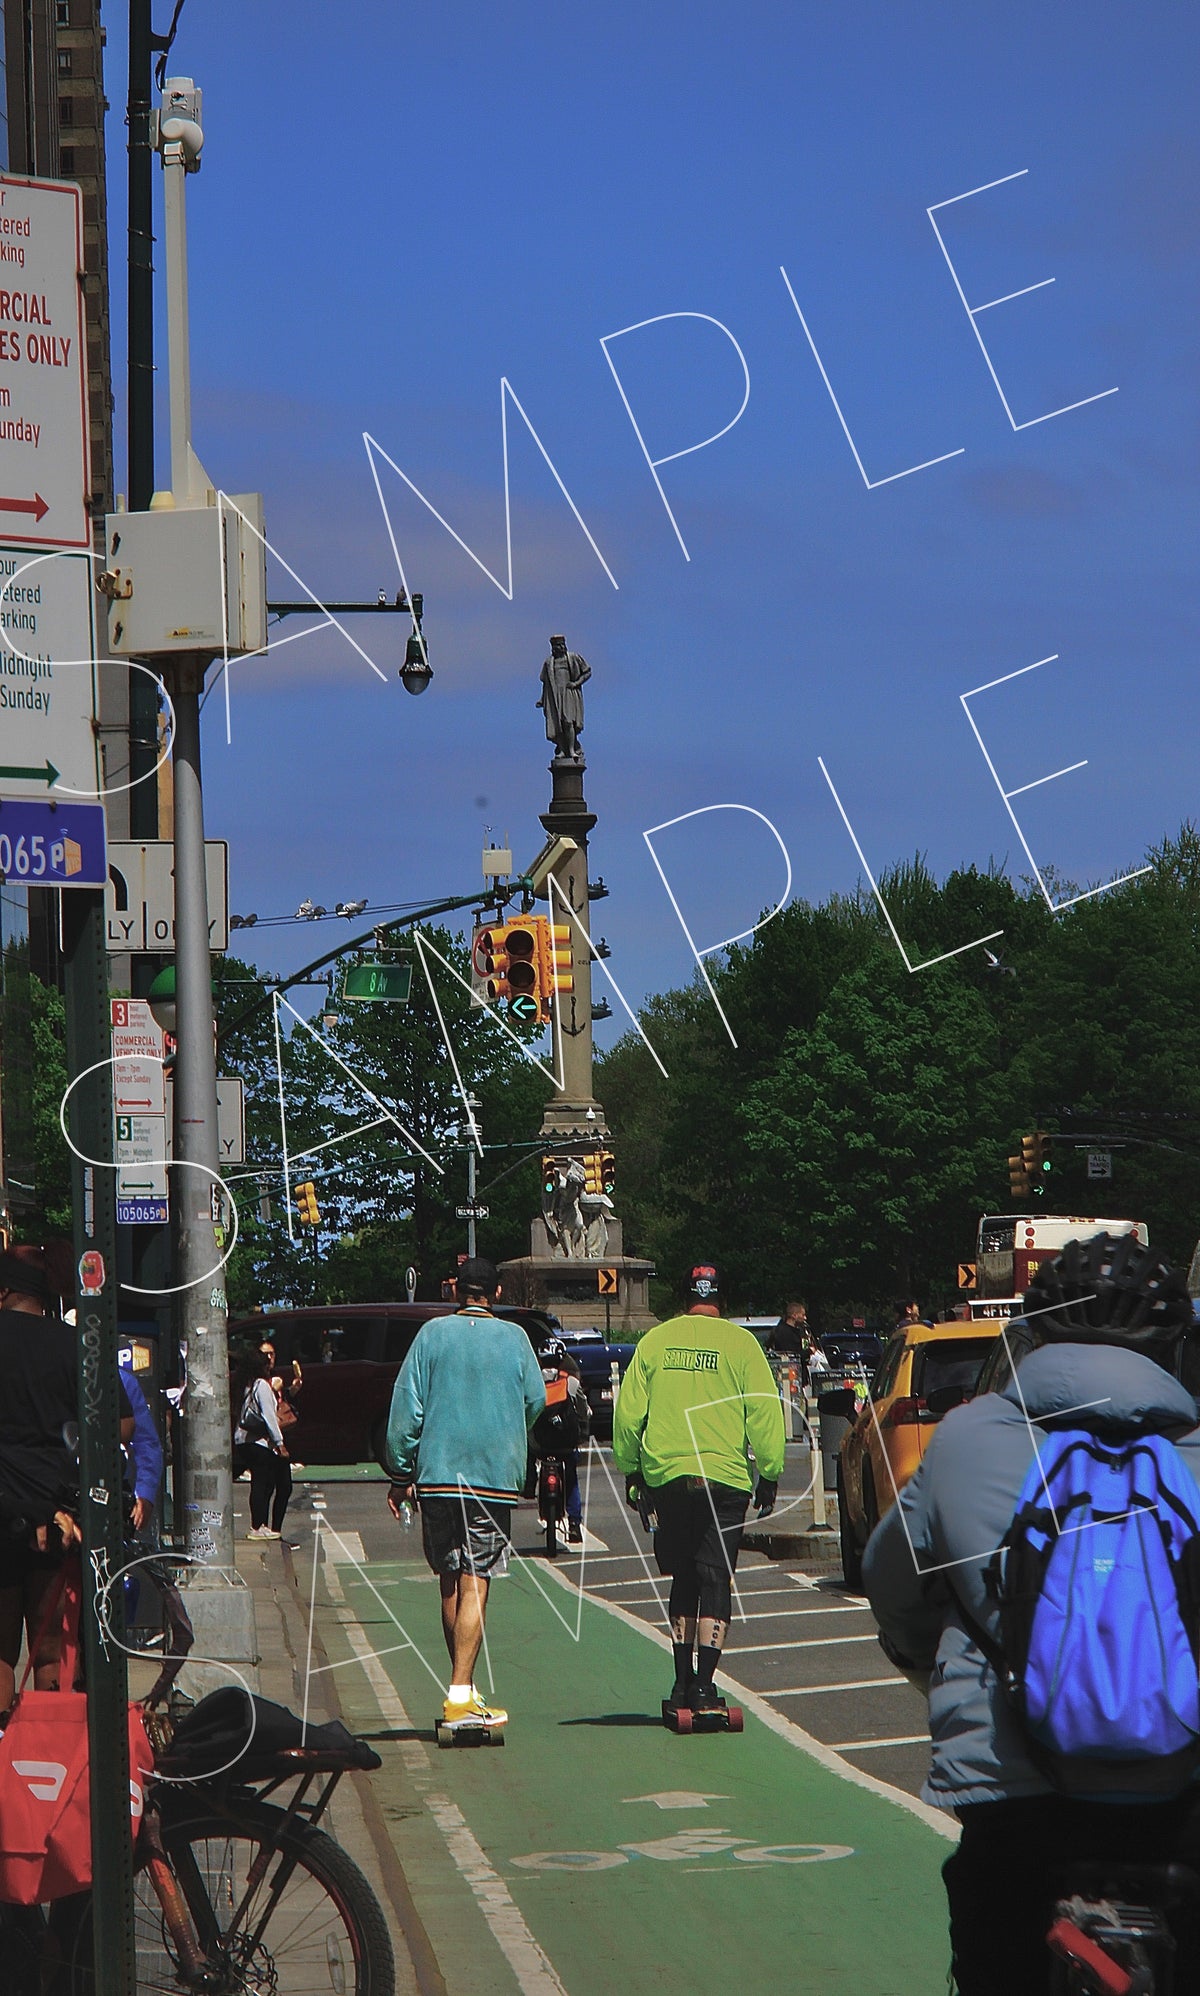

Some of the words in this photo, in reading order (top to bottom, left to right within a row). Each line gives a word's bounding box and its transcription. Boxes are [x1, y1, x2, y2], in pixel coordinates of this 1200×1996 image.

[0, 241, 25, 268] king
[0, 290, 52, 326] RCIAL
[0, 330, 21, 362] ES
[27, 333, 72, 367] ONLY
[0, 417, 41, 449] unday
[0, 684, 51, 716] Sunday
[0, 833, 46, 876] 065
[369, 971, 377, 993] 8
[377, 971, 389, 993] Av
[116, 1003, 125, 1026] 3
[115, 1035, 156, 1047] COMMERCIAL
[115, 1048, 145, 1059] VEHICLES
[146, 1048, 162, 1059] ONLY
[116, 1075, 133, 1085] Except
[134, 1075, 151, 1086] Sunday
[120, 1117, 129, 1140] 5
[118, 1206, 155, 1221] 105065
[695, 1352, 718, 1371] STEEL
